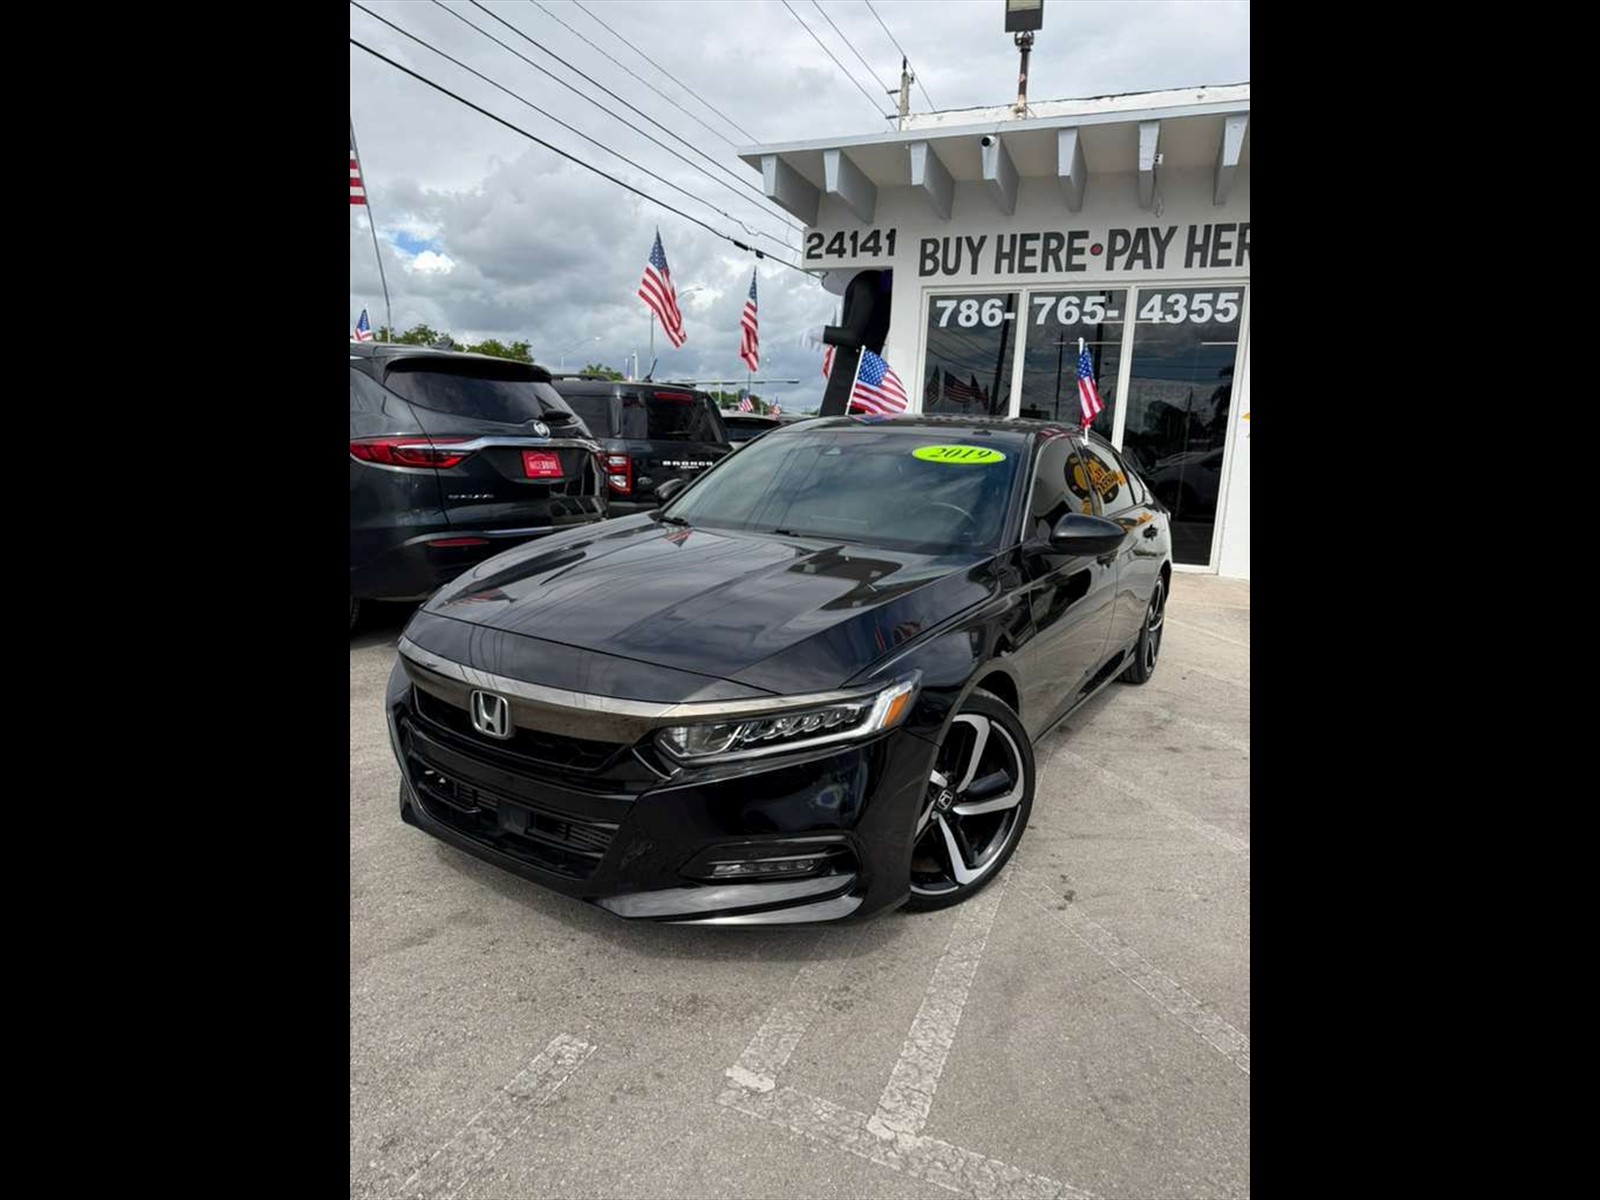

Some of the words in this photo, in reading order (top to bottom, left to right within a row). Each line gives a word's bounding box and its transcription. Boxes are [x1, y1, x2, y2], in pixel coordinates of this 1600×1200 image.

[806, 228, 896, 259] 24141
[919, 235, 987, 277] BUY
[994, 230, 1089, 274] HERE
[1105, 225, 1178, 271] PAY
[936, 298, 1016, 328] 786-
[1033, 296, 1119, 325] 765-
[1140, 292, 1239, 324] 4355
[928, 448, 992, 459] 2019
